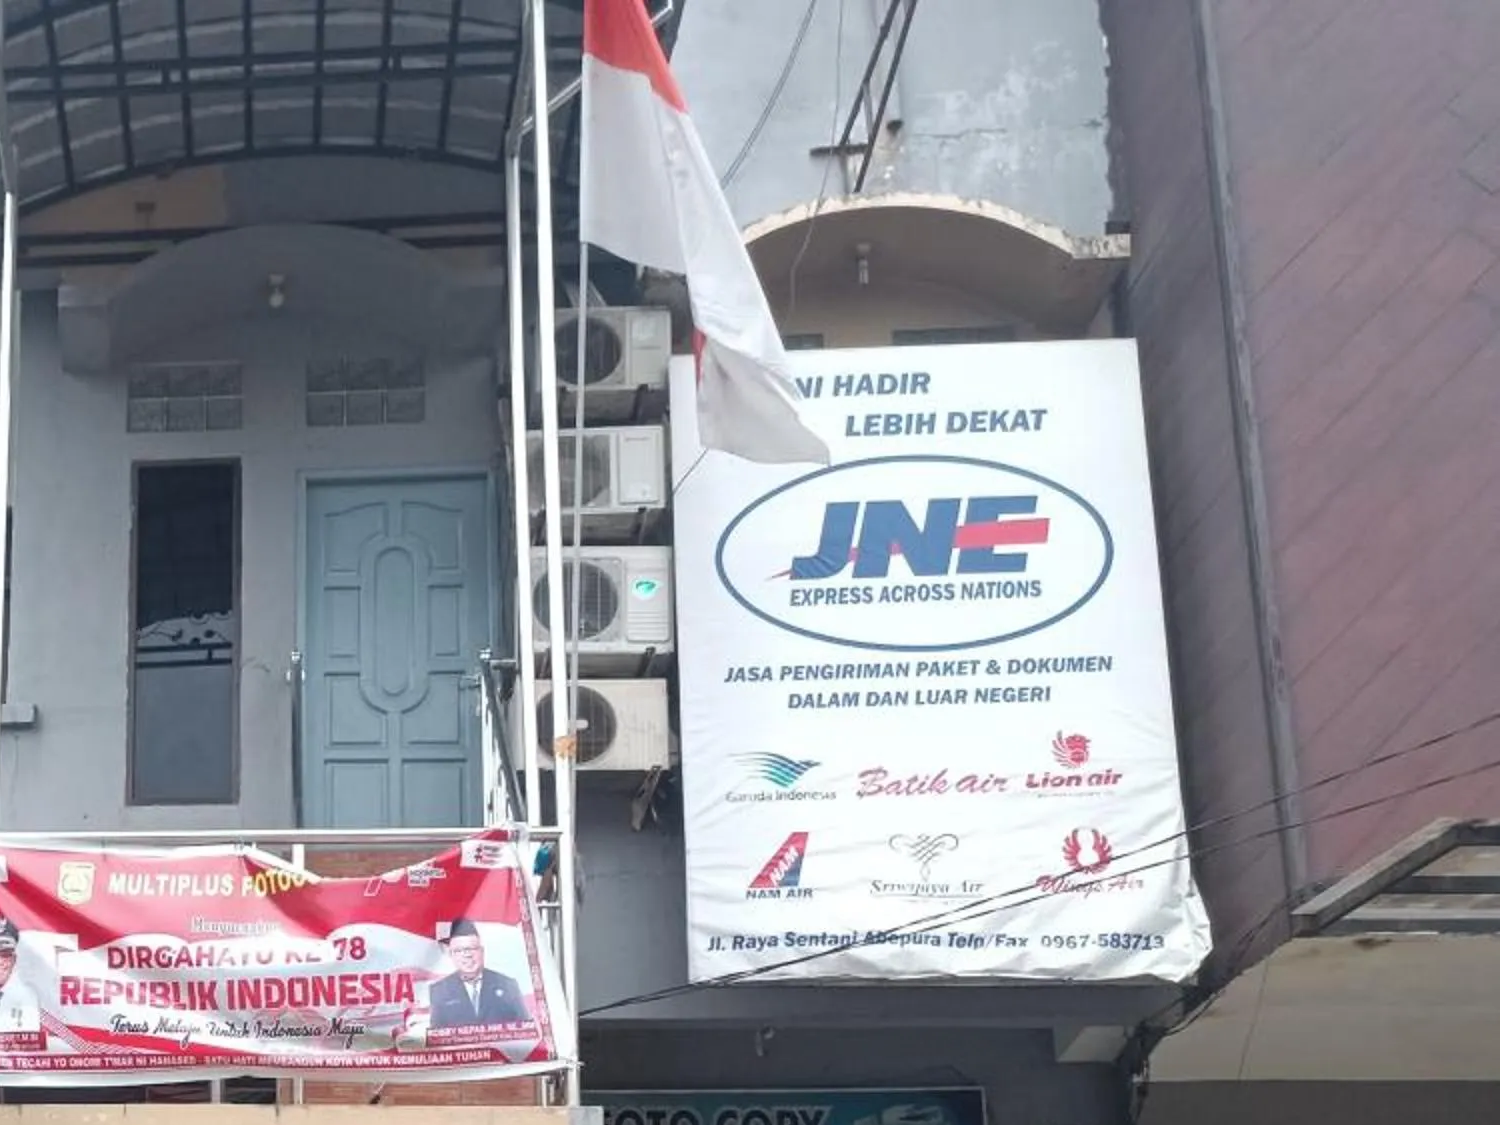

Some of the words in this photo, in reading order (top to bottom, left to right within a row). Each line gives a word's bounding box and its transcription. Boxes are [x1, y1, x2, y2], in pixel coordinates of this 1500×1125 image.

[831, 372, 932, 398] HADIR
[845, 411, 937, 438] LEBIH
[945, 408, 1048, 434] DEKAT
[788, 495, 1051, 581] JNE
[789, 586, 874, 607] EXPRESS
[878, 583, 956, 604] ACROSS
[959, 580, 1042, 601] NATIONS
[724, 666, 773, 684] JASA
[779, 661, 911, 682] PENGIRIMAN
[915, 659, 981, 678] PAKET
[985, 659, 1002, 675] &
[1007, 655, 1113, 676] DOKUMEN
[787, 691, 860, 710] DALAM
[865, 690, 910, 708] DAN
[915, 688, 969, 706] LUAR
[973, 686, 1052, 704] NEGERI
[856, 766, 950, 799] Batik
[954, 772, 1010, 795] air
[1025, 771, 1083, 789] Lion
[1086, 768, 1123, 787] air
[107, 872, 234, 897] MULTIPLUS
[745, 889, 781, 900] NAM
[785, 887, 814, 898] AIR
[332, 936, 367, 961] 78
[707, 935, 727, 952] Jl.
[731, 934, 779, 953] Raya
[783, 931, 858, 949] Sentani
[862, 930, 942, 950] Abepura
[1040, 933, 1165, 951] 0967-583713
[59, 974, 219, 1011] REPUBLIK
[226, 971, 416, 1010] INDONESIA
[110, 1013, 150, 1034] Terus
[253, 1020, 323, 1039] Indonesia
[326, 1017, 366, 1049] Maju
[355, 1054, 391, 1066] UNTUK
[455, 1049, 492, 1062] TUHAN
